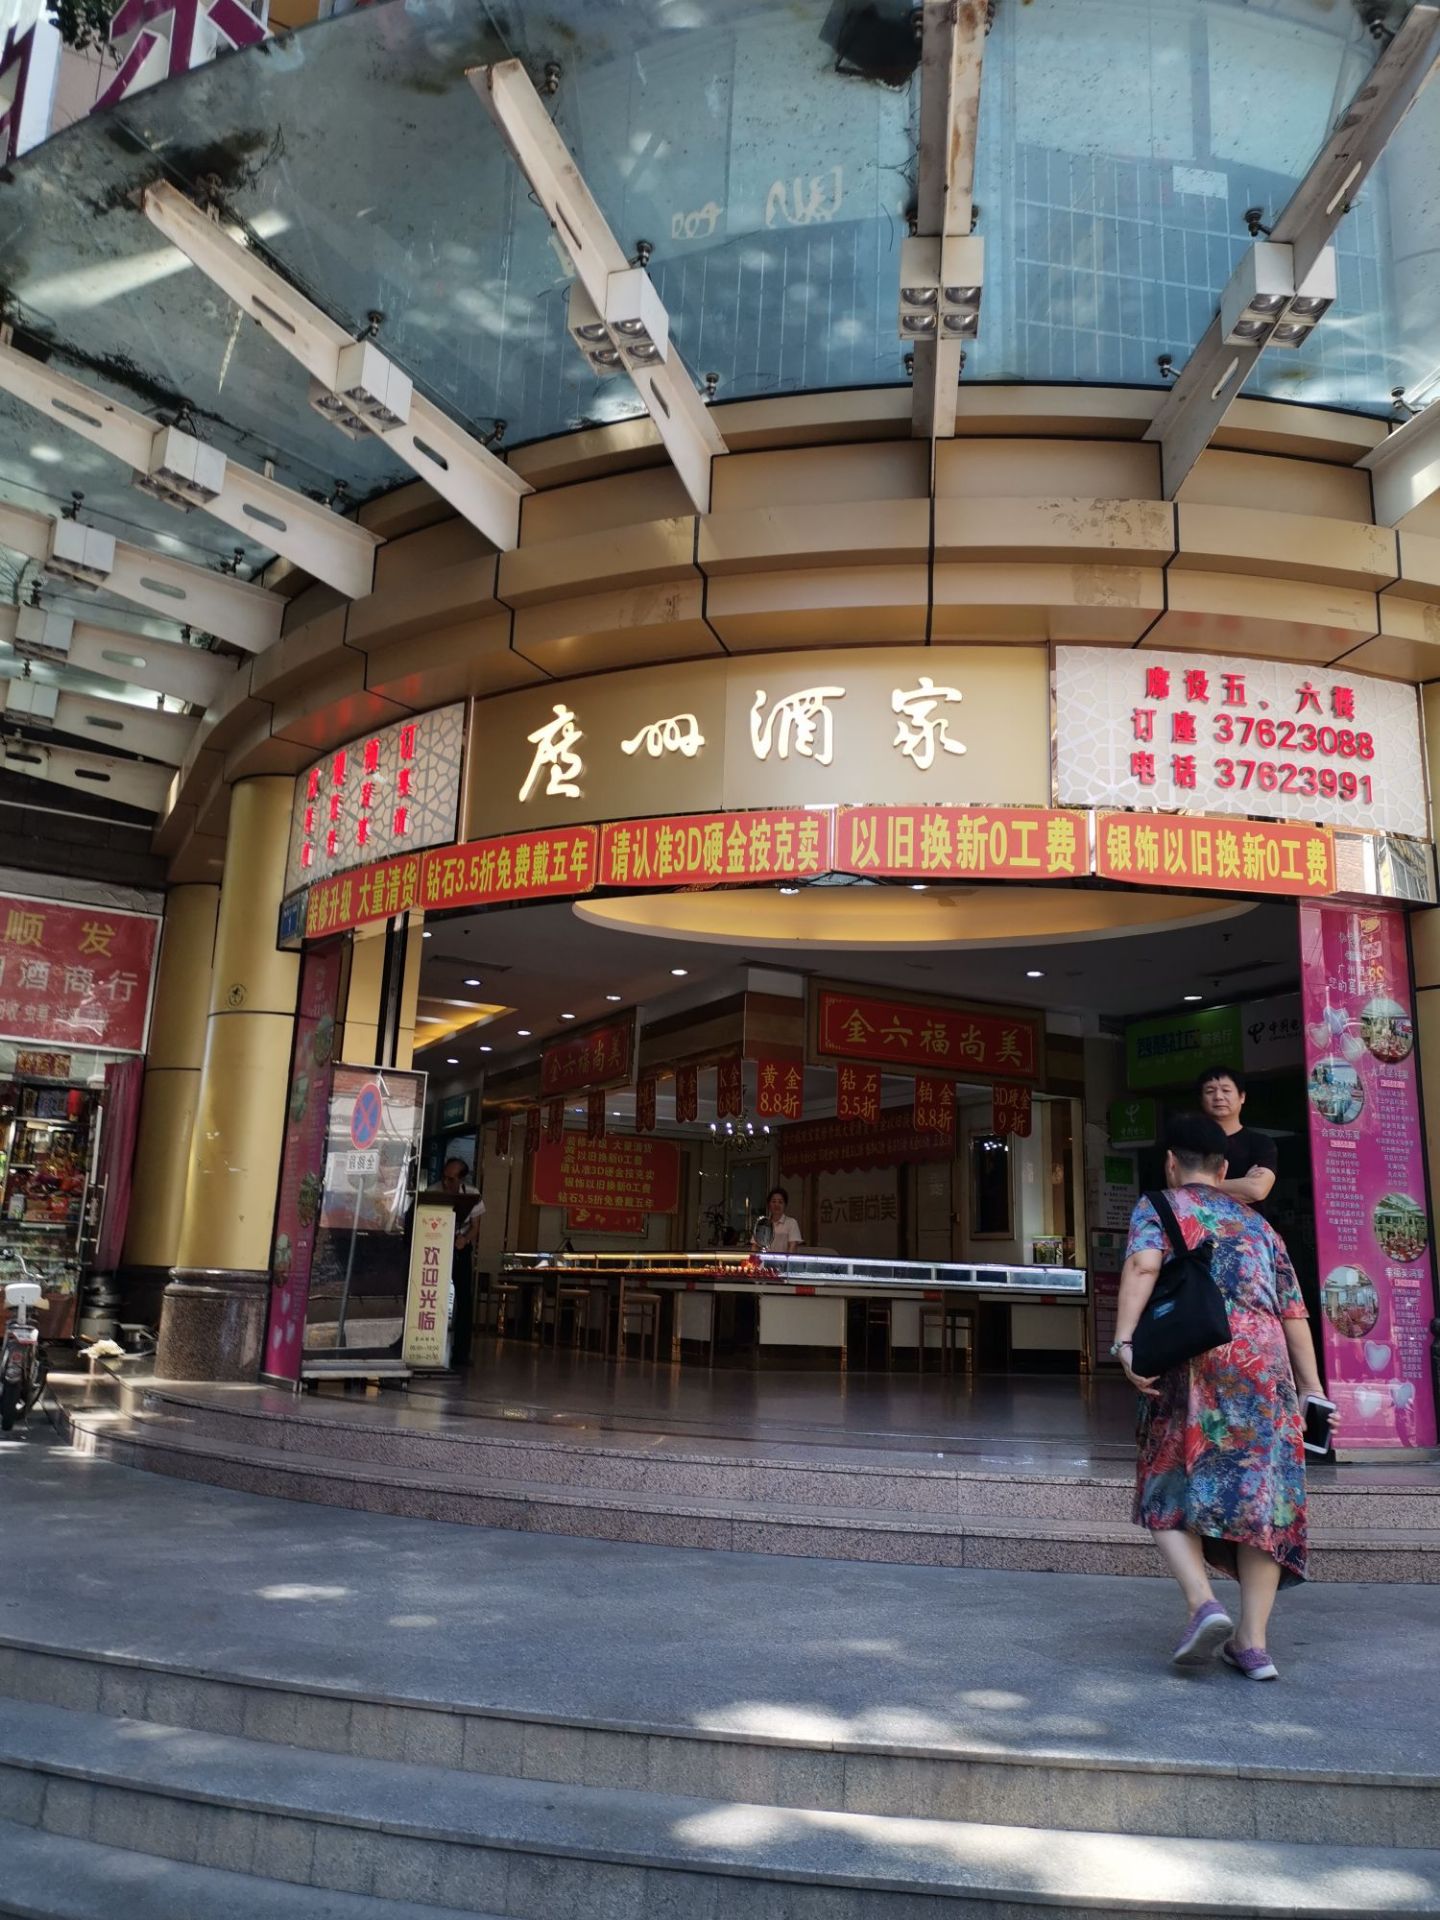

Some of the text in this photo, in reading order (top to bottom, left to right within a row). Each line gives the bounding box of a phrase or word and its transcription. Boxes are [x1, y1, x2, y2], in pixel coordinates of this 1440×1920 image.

[1131, 707, 1375, 761] 订座 37623088
[1130, 751, 1374, 804] 电话 37623991
[426, 838, 589, 901] 钻石3.5折免费戴五年
[611, 818, 819, 881] 请认准3D硬金按克卖
[851, 814, 1077, 874] 以旧换新0工费
[1106, 823, 1328, 888] 银饰以旧换新0工费
[307, 863, 418, 933] 装修升级 大量清货
[4, 909, 116, 957] 顺发
[841, 1009, 1023, 1067] 金六福尚美
[760, 1066, 802, 1090] 黄金
[840, 1069, 877, 1093] 钻石
[919, 1080, 955, 1105] 铂金
[760, 1092, 799, 1118] 8.8折
[840, 1097, 878, 1122] 3.5折
[917, 1108, 953, 1134] 8.8折
[999, 1112, 1026, 1133] 9折
[418, 1246, 441, 1331] 欢迎光临
